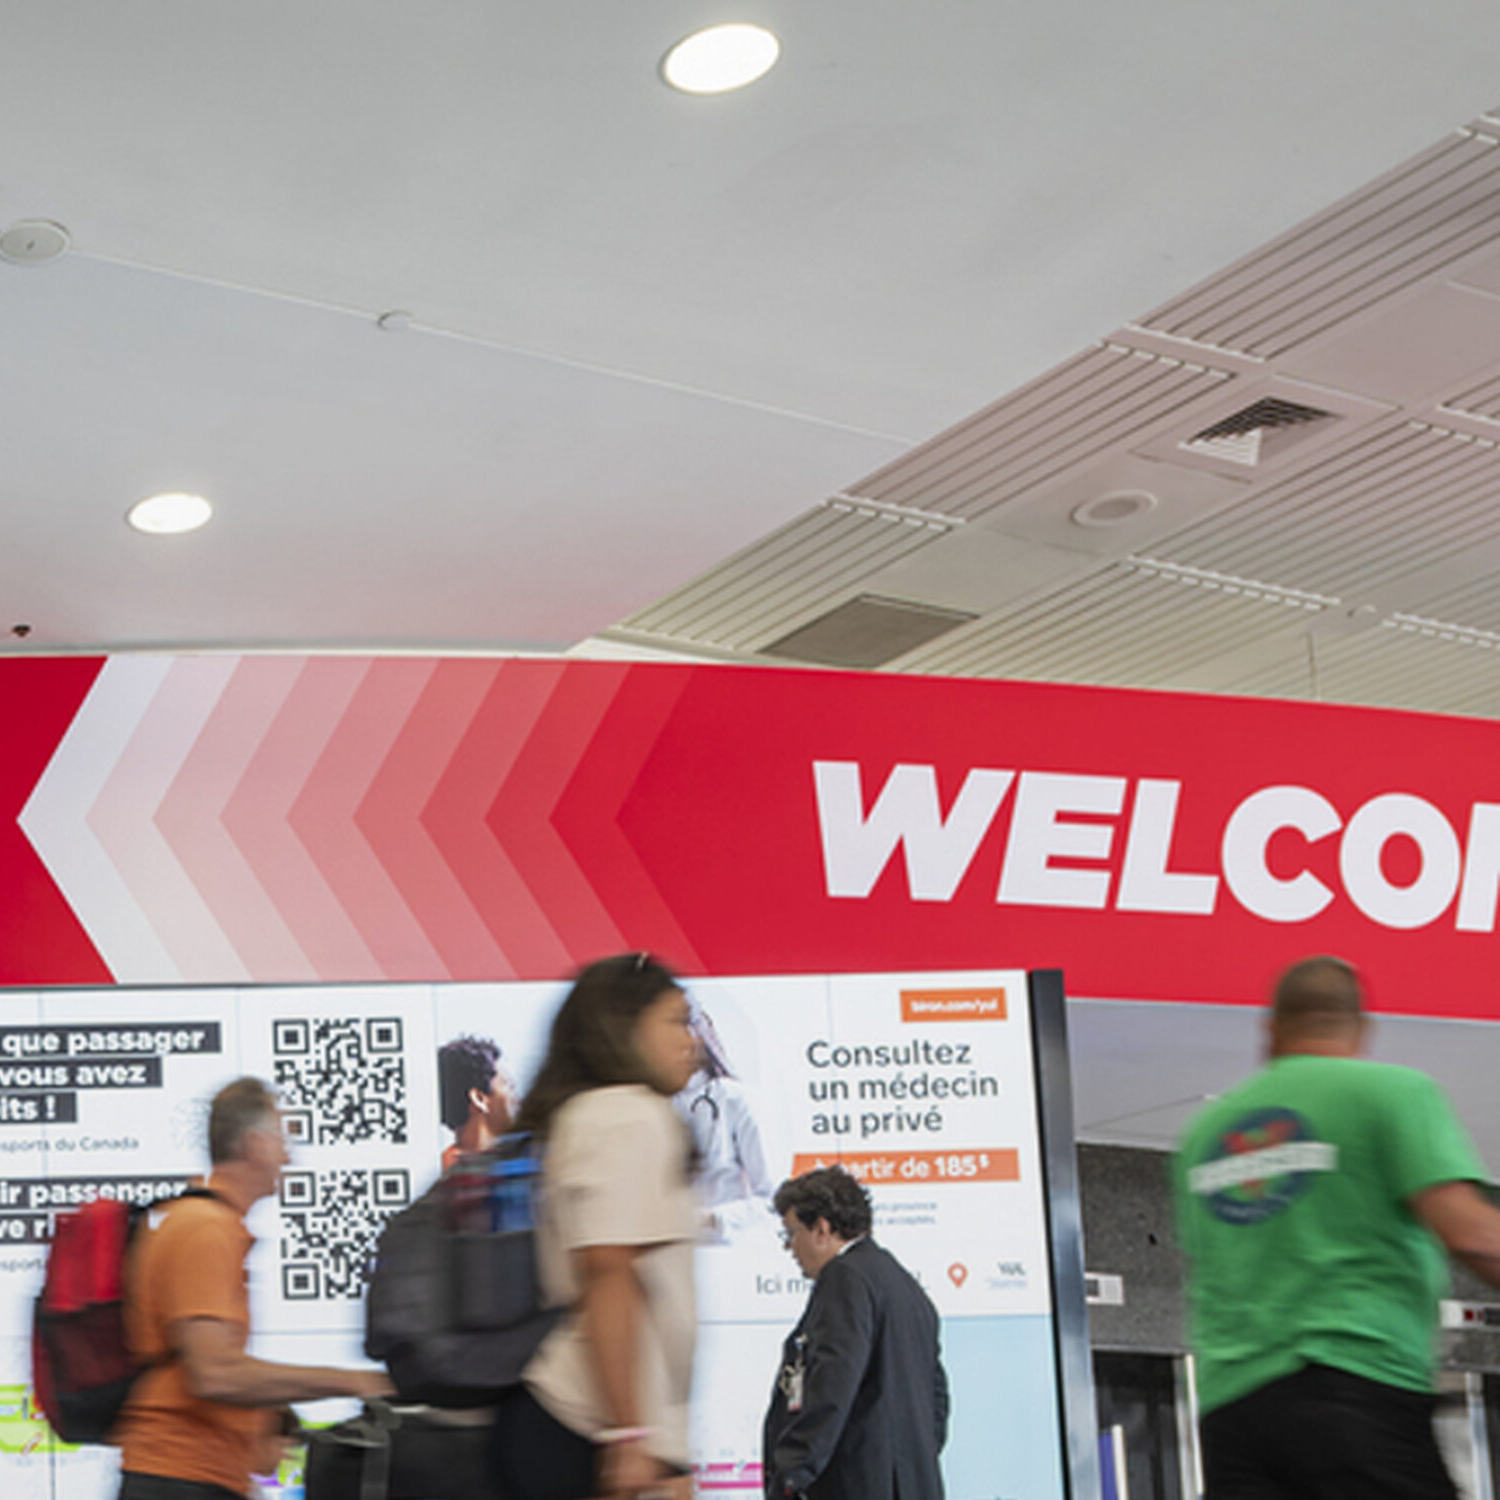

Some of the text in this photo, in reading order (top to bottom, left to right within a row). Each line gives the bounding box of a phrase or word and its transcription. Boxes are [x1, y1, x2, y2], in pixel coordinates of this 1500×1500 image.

[2, 1033, 60, 1057] que
[67, 1029, 205, 1057] passager
[807, 1039, 971, 1068] Consultez
[75, 1064, 147, 1085] avez
[809, 1071, 999, 1101] un médecin
[811, 1105, 943, 1139] au privé
[55, 1137, 76, 1151] du
[80, 1136, 139, 1151] Canada
[902, 1157, 930, 1178] de
[30, 1181, 188, 1208] passenger
[756, 1275, 782, 1294] Ici
